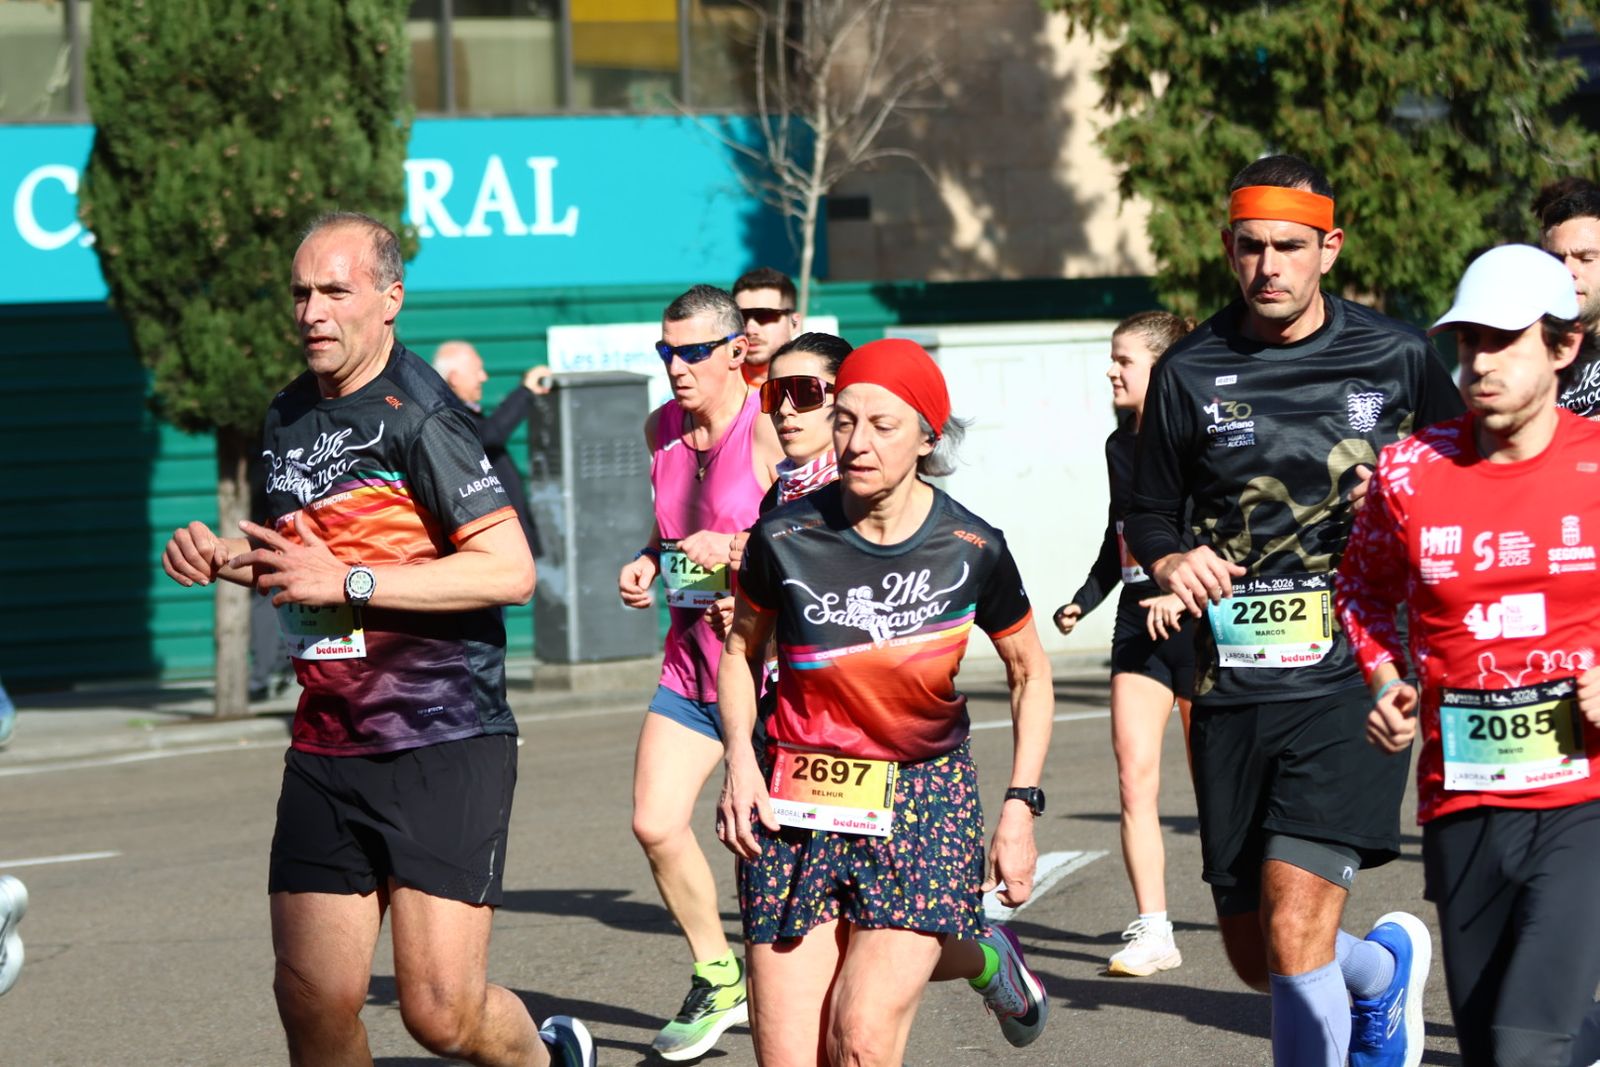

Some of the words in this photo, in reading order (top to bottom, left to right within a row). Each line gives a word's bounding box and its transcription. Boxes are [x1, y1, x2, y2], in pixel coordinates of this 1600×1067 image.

[953, 528, 987, 548] 42K
[1271, 578, 1294, 588] 2026
[1232, 598, 1306, 625] 2262
[316, 645, 353, 655] bedunia
[1281, 653, 1322, 662] bedunia
[1467, 709, 1555, 742] 2085
[792, 756, 872, 787] 2697
[1525, 768, 1574, 784] bedunia
[811, 789, 844, 799] BELHUR
[832, 817, 877, 830] bedunia
